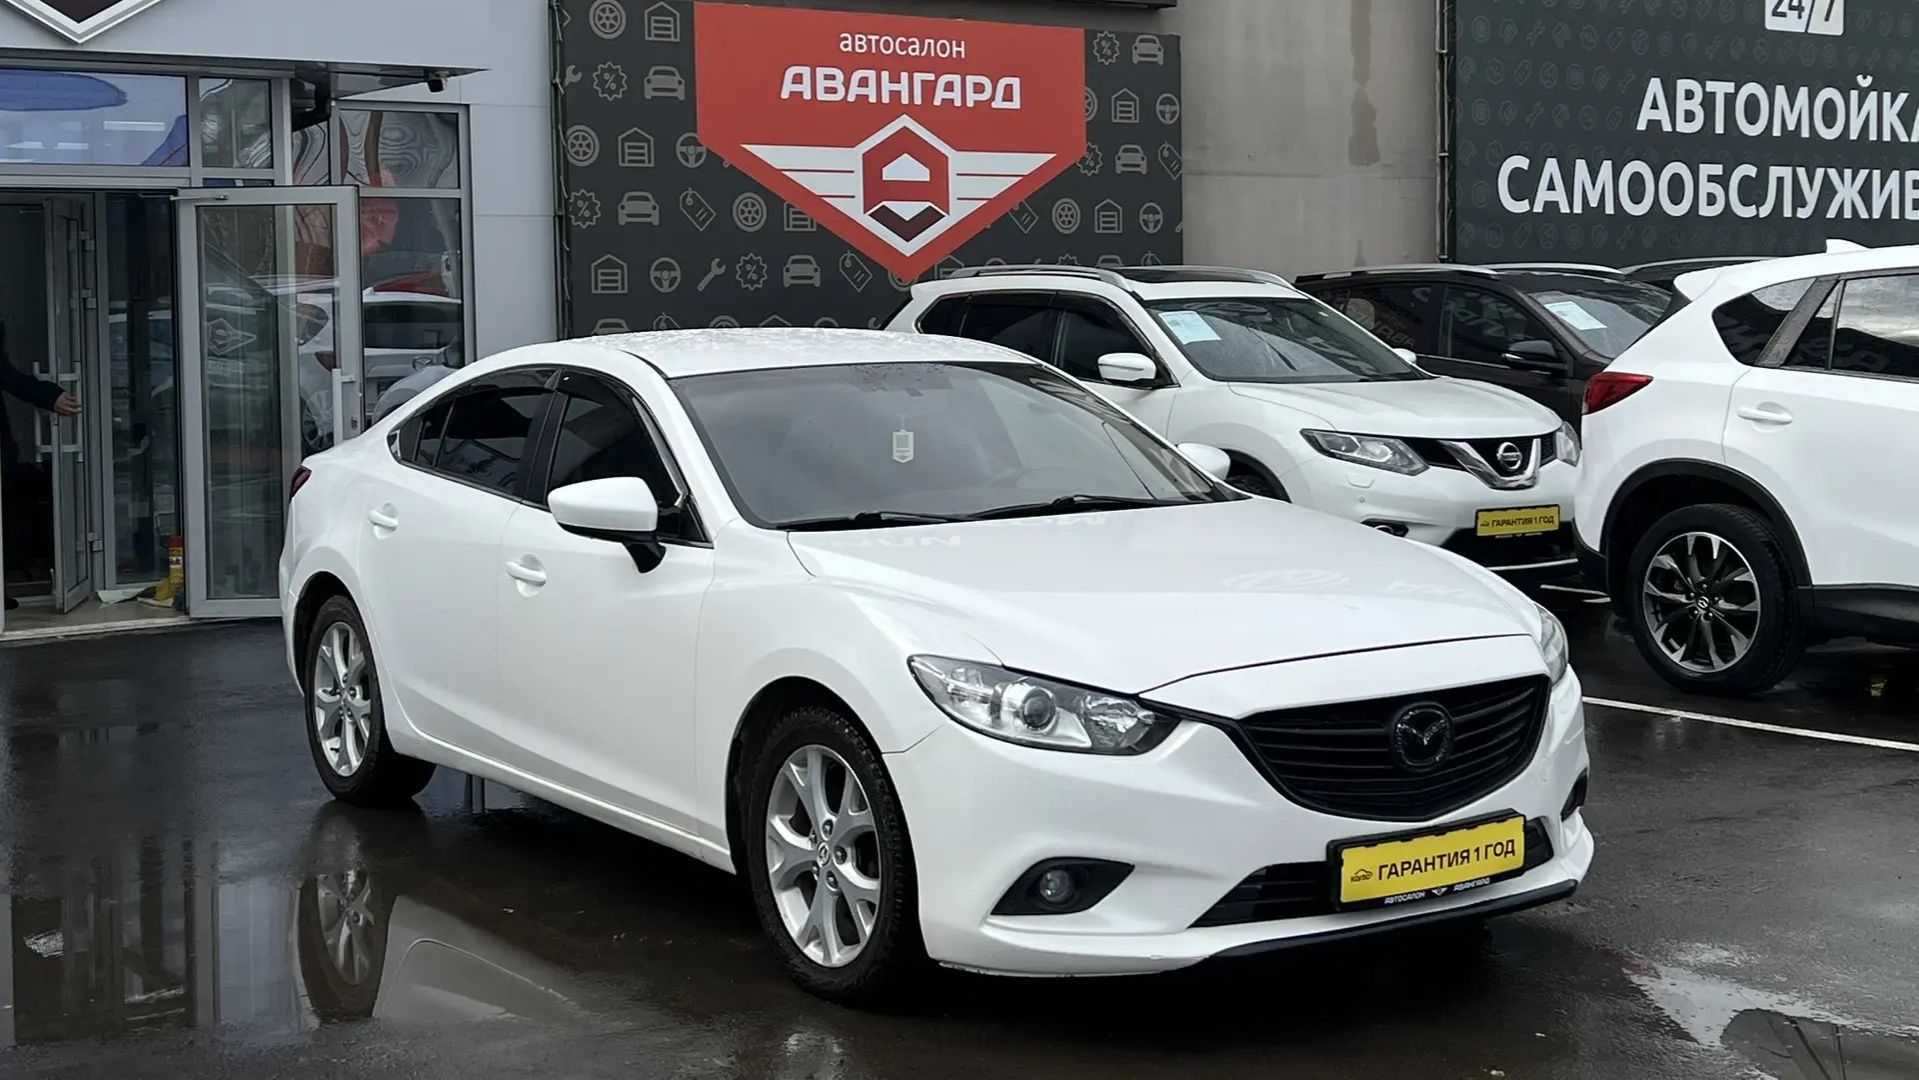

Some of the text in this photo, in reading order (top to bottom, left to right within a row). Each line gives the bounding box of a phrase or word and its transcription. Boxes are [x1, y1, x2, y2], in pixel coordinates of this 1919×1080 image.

[839, 32, 965, 59] автосалон
[780, 65, 1021, 110] АВАНГАРД
[1636, 73, 1919, 143] АВТОМОЙК
[1491, 517, 1533, 528] ГАРАНТИЯ
[1538, 515, 1554, 525] ГОД
[1377, 839, 1516, 881] ГАРАНТИЯ 1 ГОД
